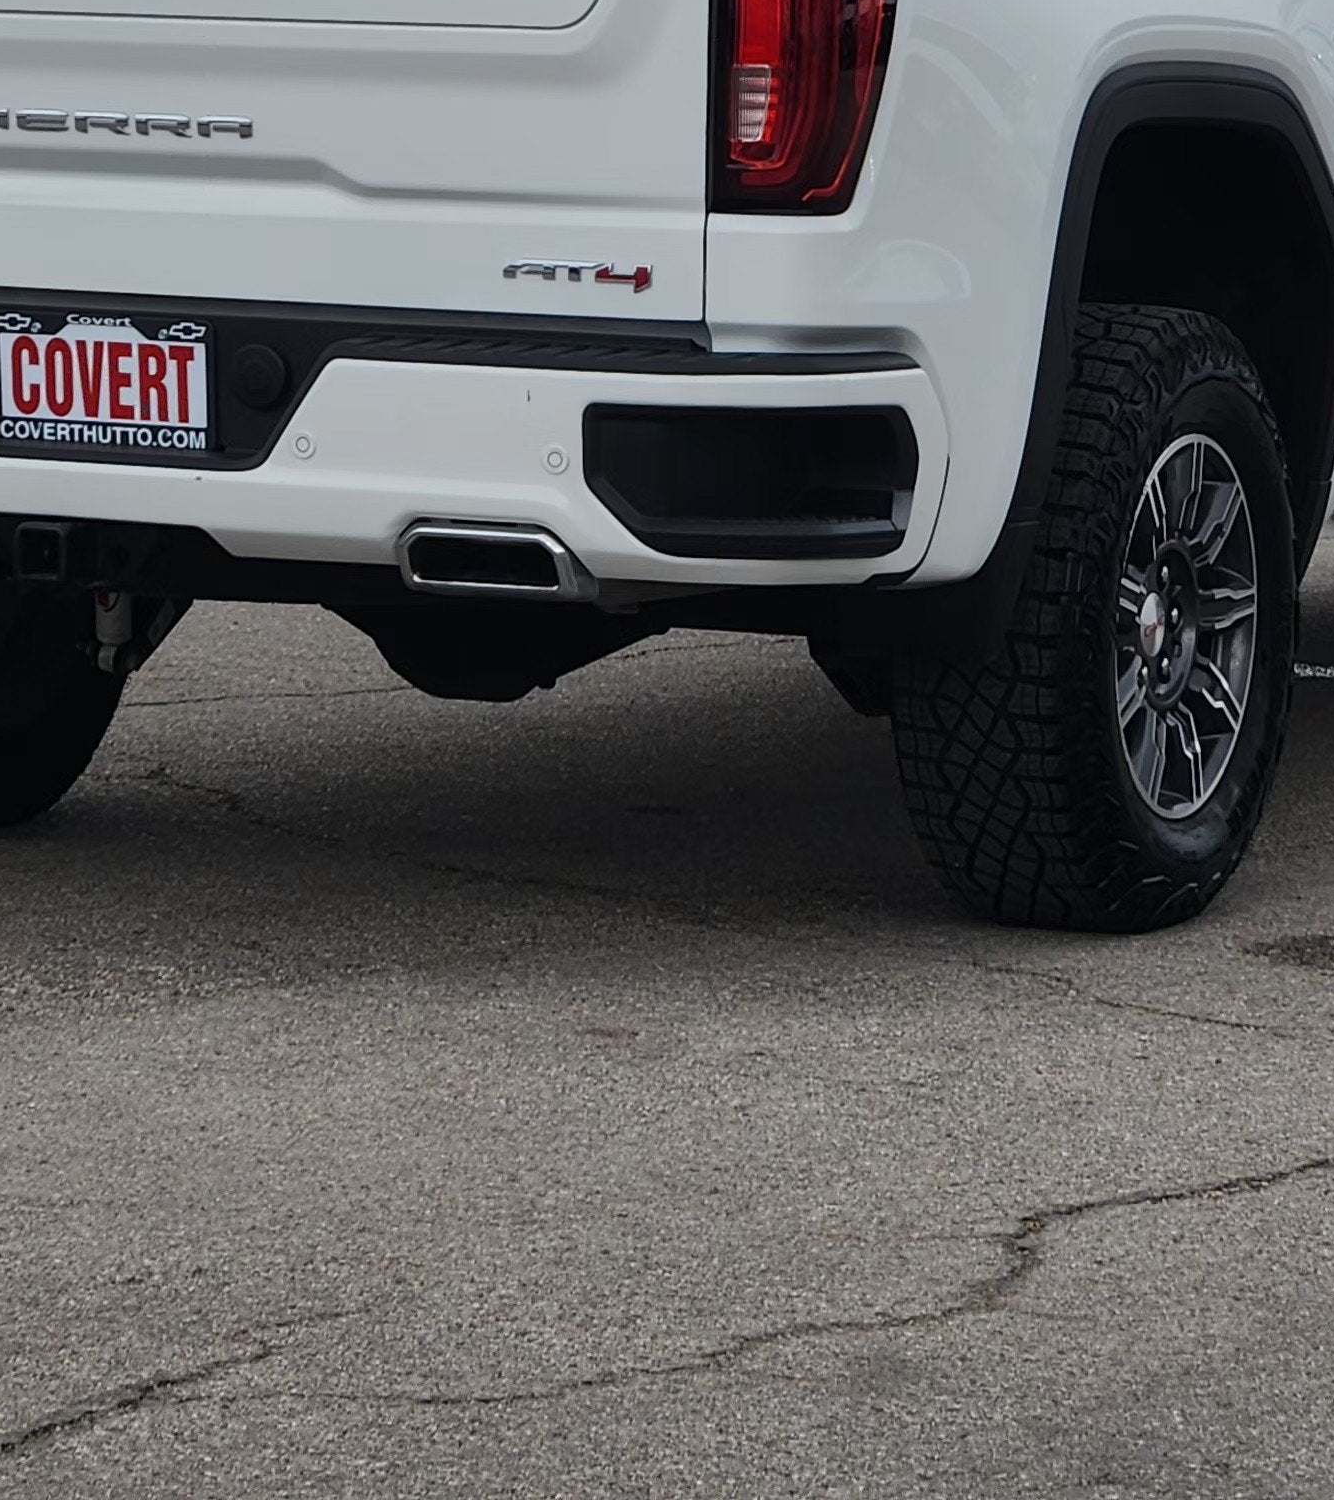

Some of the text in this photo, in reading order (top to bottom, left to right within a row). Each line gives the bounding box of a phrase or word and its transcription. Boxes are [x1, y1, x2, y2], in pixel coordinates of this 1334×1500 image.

[502, 257, 653, 295] AT4
[65, 312, 132, 328] Covert
[11, 335, 195, 423] COVERT
[0, 419, 207, 450] COVERTHUTTO.COM
